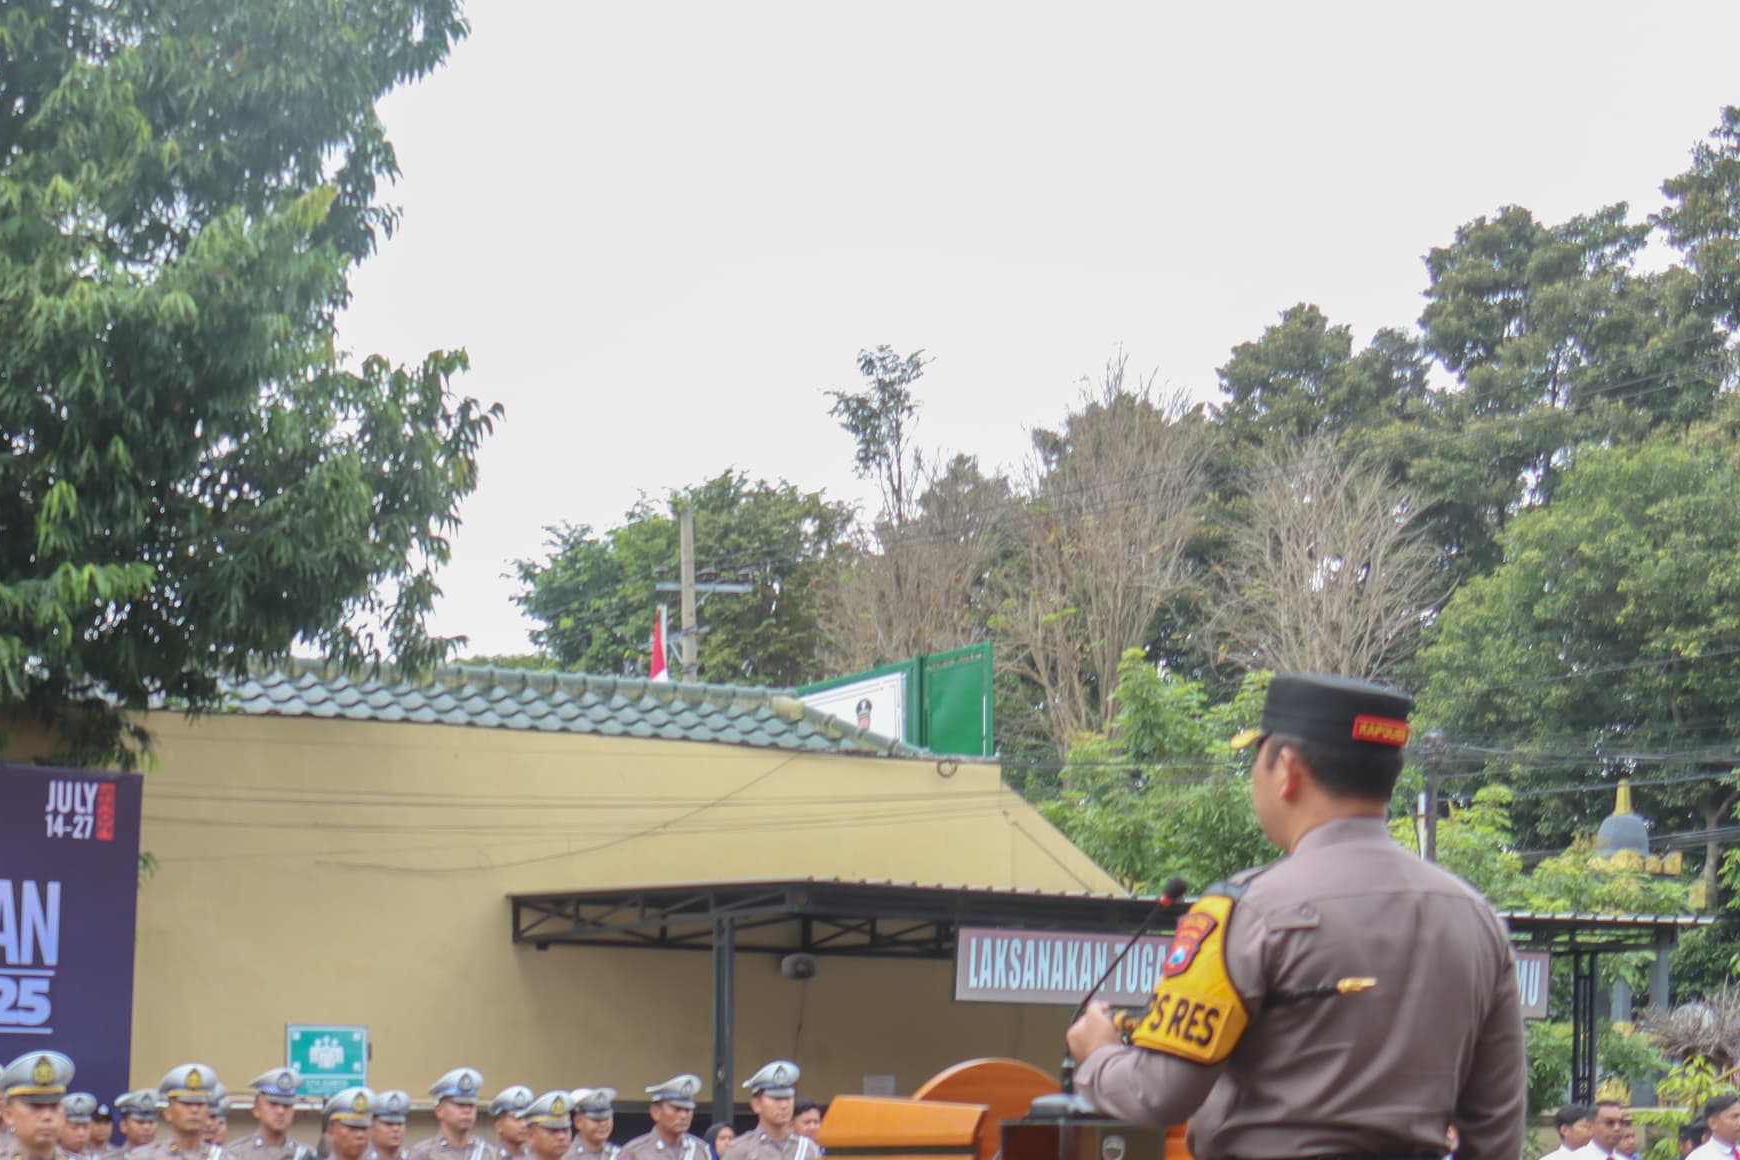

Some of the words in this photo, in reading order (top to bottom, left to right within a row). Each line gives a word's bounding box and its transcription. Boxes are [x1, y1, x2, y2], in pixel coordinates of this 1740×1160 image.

[45, 780, 98, 814] JULY
[45, 813, 94, 839] 14-27
[968, 936, 1108, 993] LAKSANAKAN
[1114, 943, 1168, 994] TUGA
